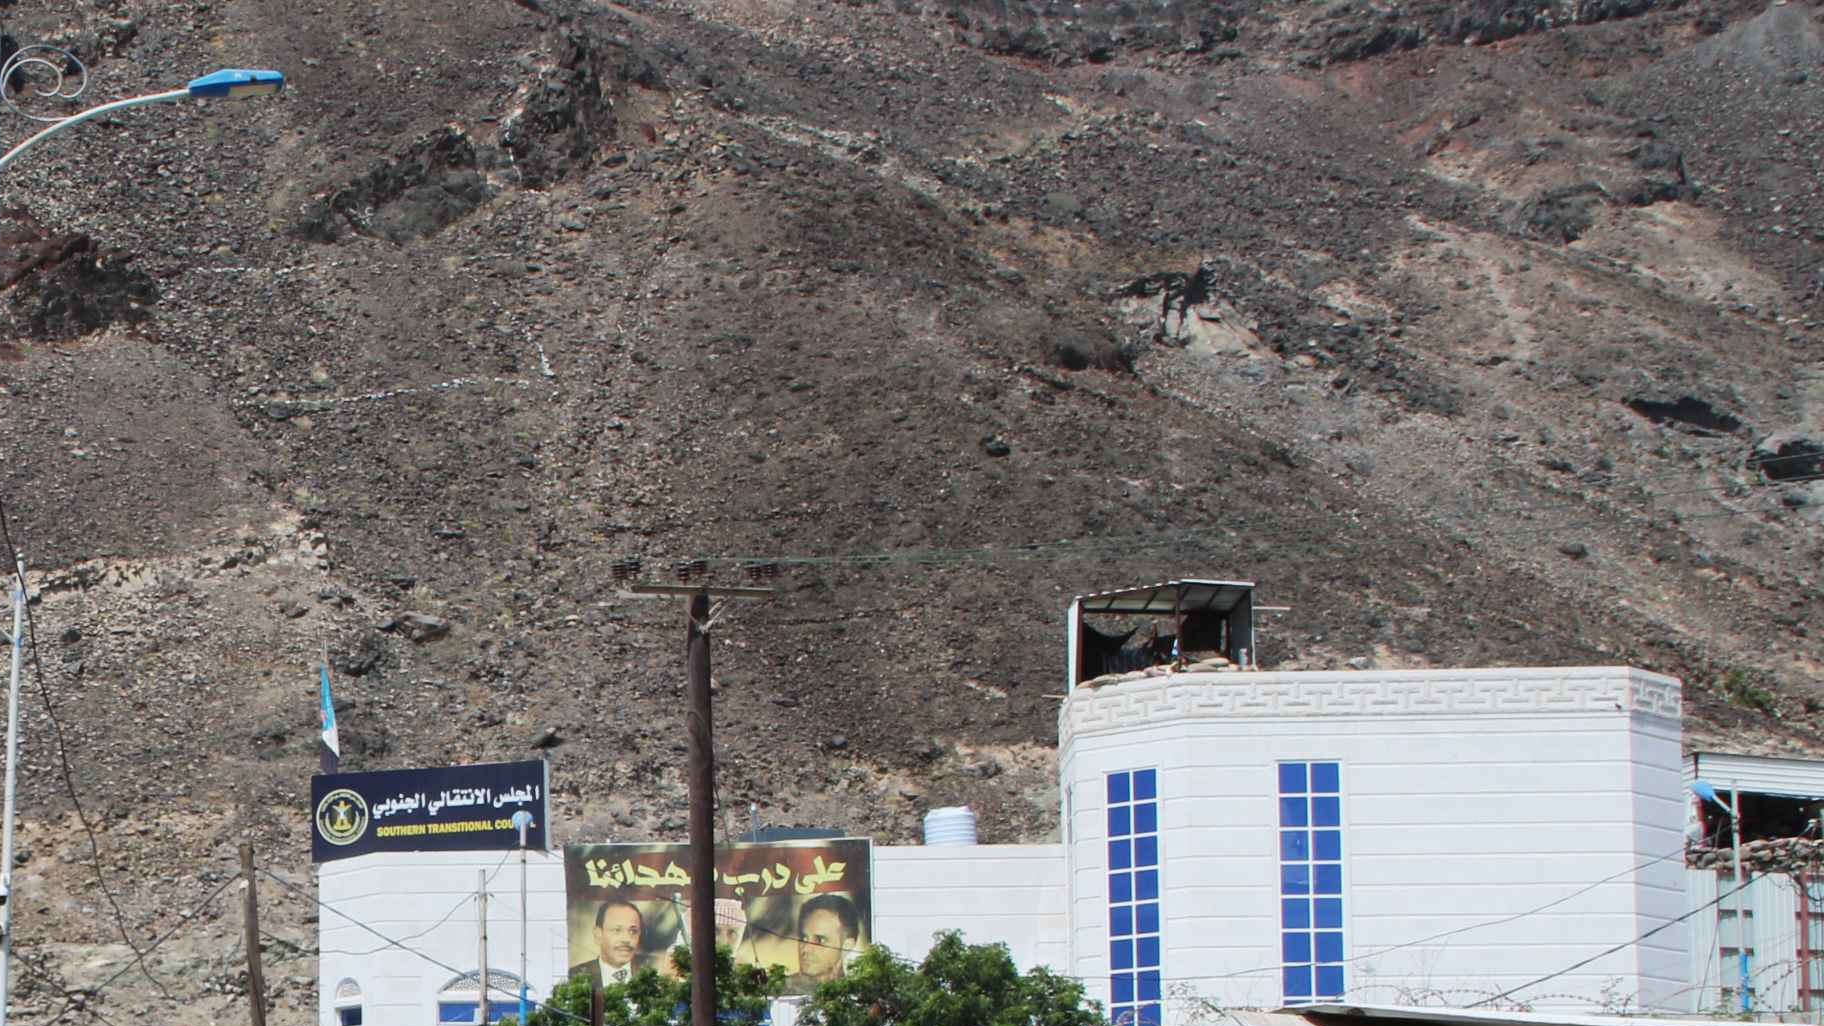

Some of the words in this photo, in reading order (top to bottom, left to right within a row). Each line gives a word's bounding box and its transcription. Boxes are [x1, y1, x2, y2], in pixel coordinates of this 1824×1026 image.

[372, 792, 426, 819] الجنوبي
[428, 788, 491, 816] الانتقالي
[493, 784, 540, 808] المجلس
[376, 824, 426, 837] SOUTHERN
[428, 820, 493, 835] TRANSITIONAL
[723, 863, 791, 896] درب
